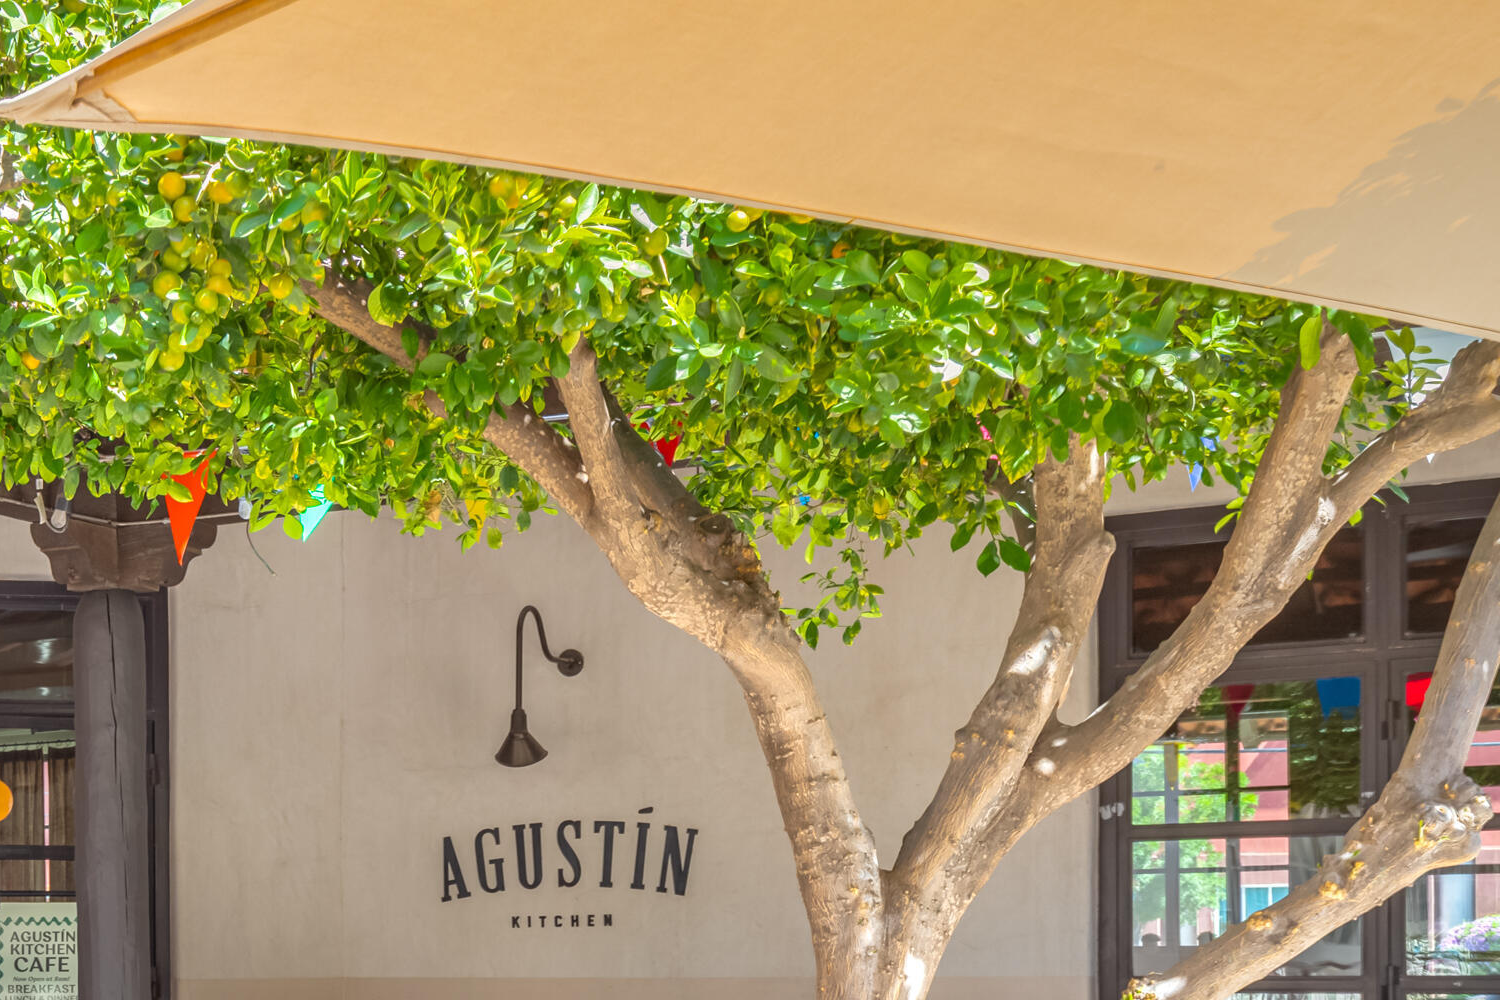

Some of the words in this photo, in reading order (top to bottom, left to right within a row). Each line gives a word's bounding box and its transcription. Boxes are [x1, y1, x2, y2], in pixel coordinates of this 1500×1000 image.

[441, 806, 699, 903] AGUSTÍN
[511, 913, 614, 928] KITCHEN
[10, 929, 76, 942] AGUSTÍN
[10, 943, 76, 955] KITCHEN
[14, 956, 70, 973] CAFE
[7, 984, 76, 994] BREAKFAST
